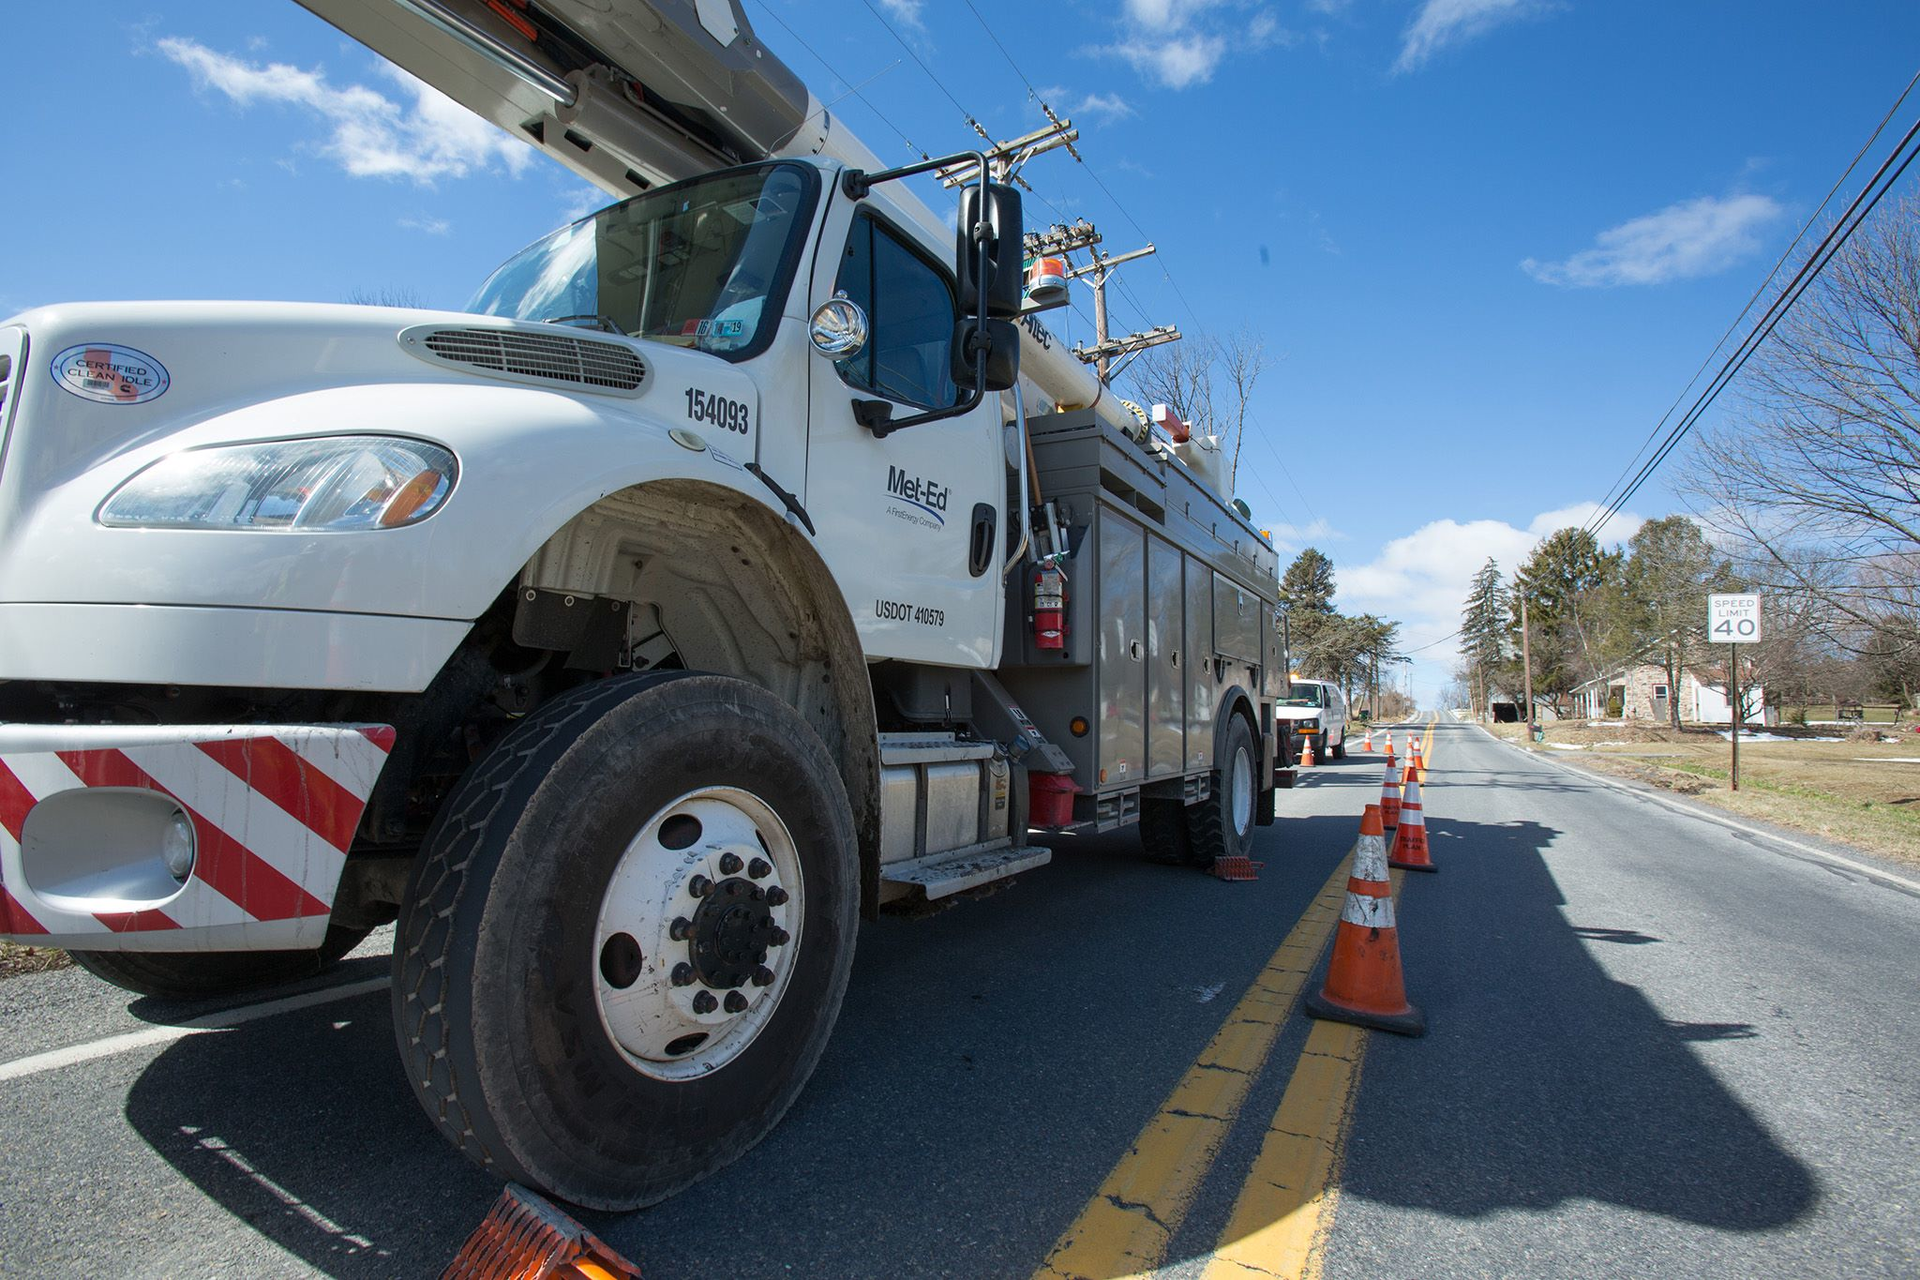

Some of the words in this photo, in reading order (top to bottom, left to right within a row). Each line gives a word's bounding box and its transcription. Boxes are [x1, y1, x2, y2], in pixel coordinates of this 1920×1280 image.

[697, 320, 709, 335] 16
[731, 321, 742, 333] 19
[75, 359, 147, 376] CERTIFIED
[67, 368, 116, 381] CLEAN
[121, 375, 152, 387] IDLE
[685, 387, 749, 435] 154093
[886, 506, 892, 514] A
[892, 507, 919, 525] FirstEnergy
[919, 516, 942, 532] Company
[1714, 599, 1755, 608] SPEED
[875, 599, 914, 622] USDOT
[914, 606, 945, 627] 410579
[1718, 609, 1750, 617] LIMIT
[1713, 619, 1756, 636] 40
